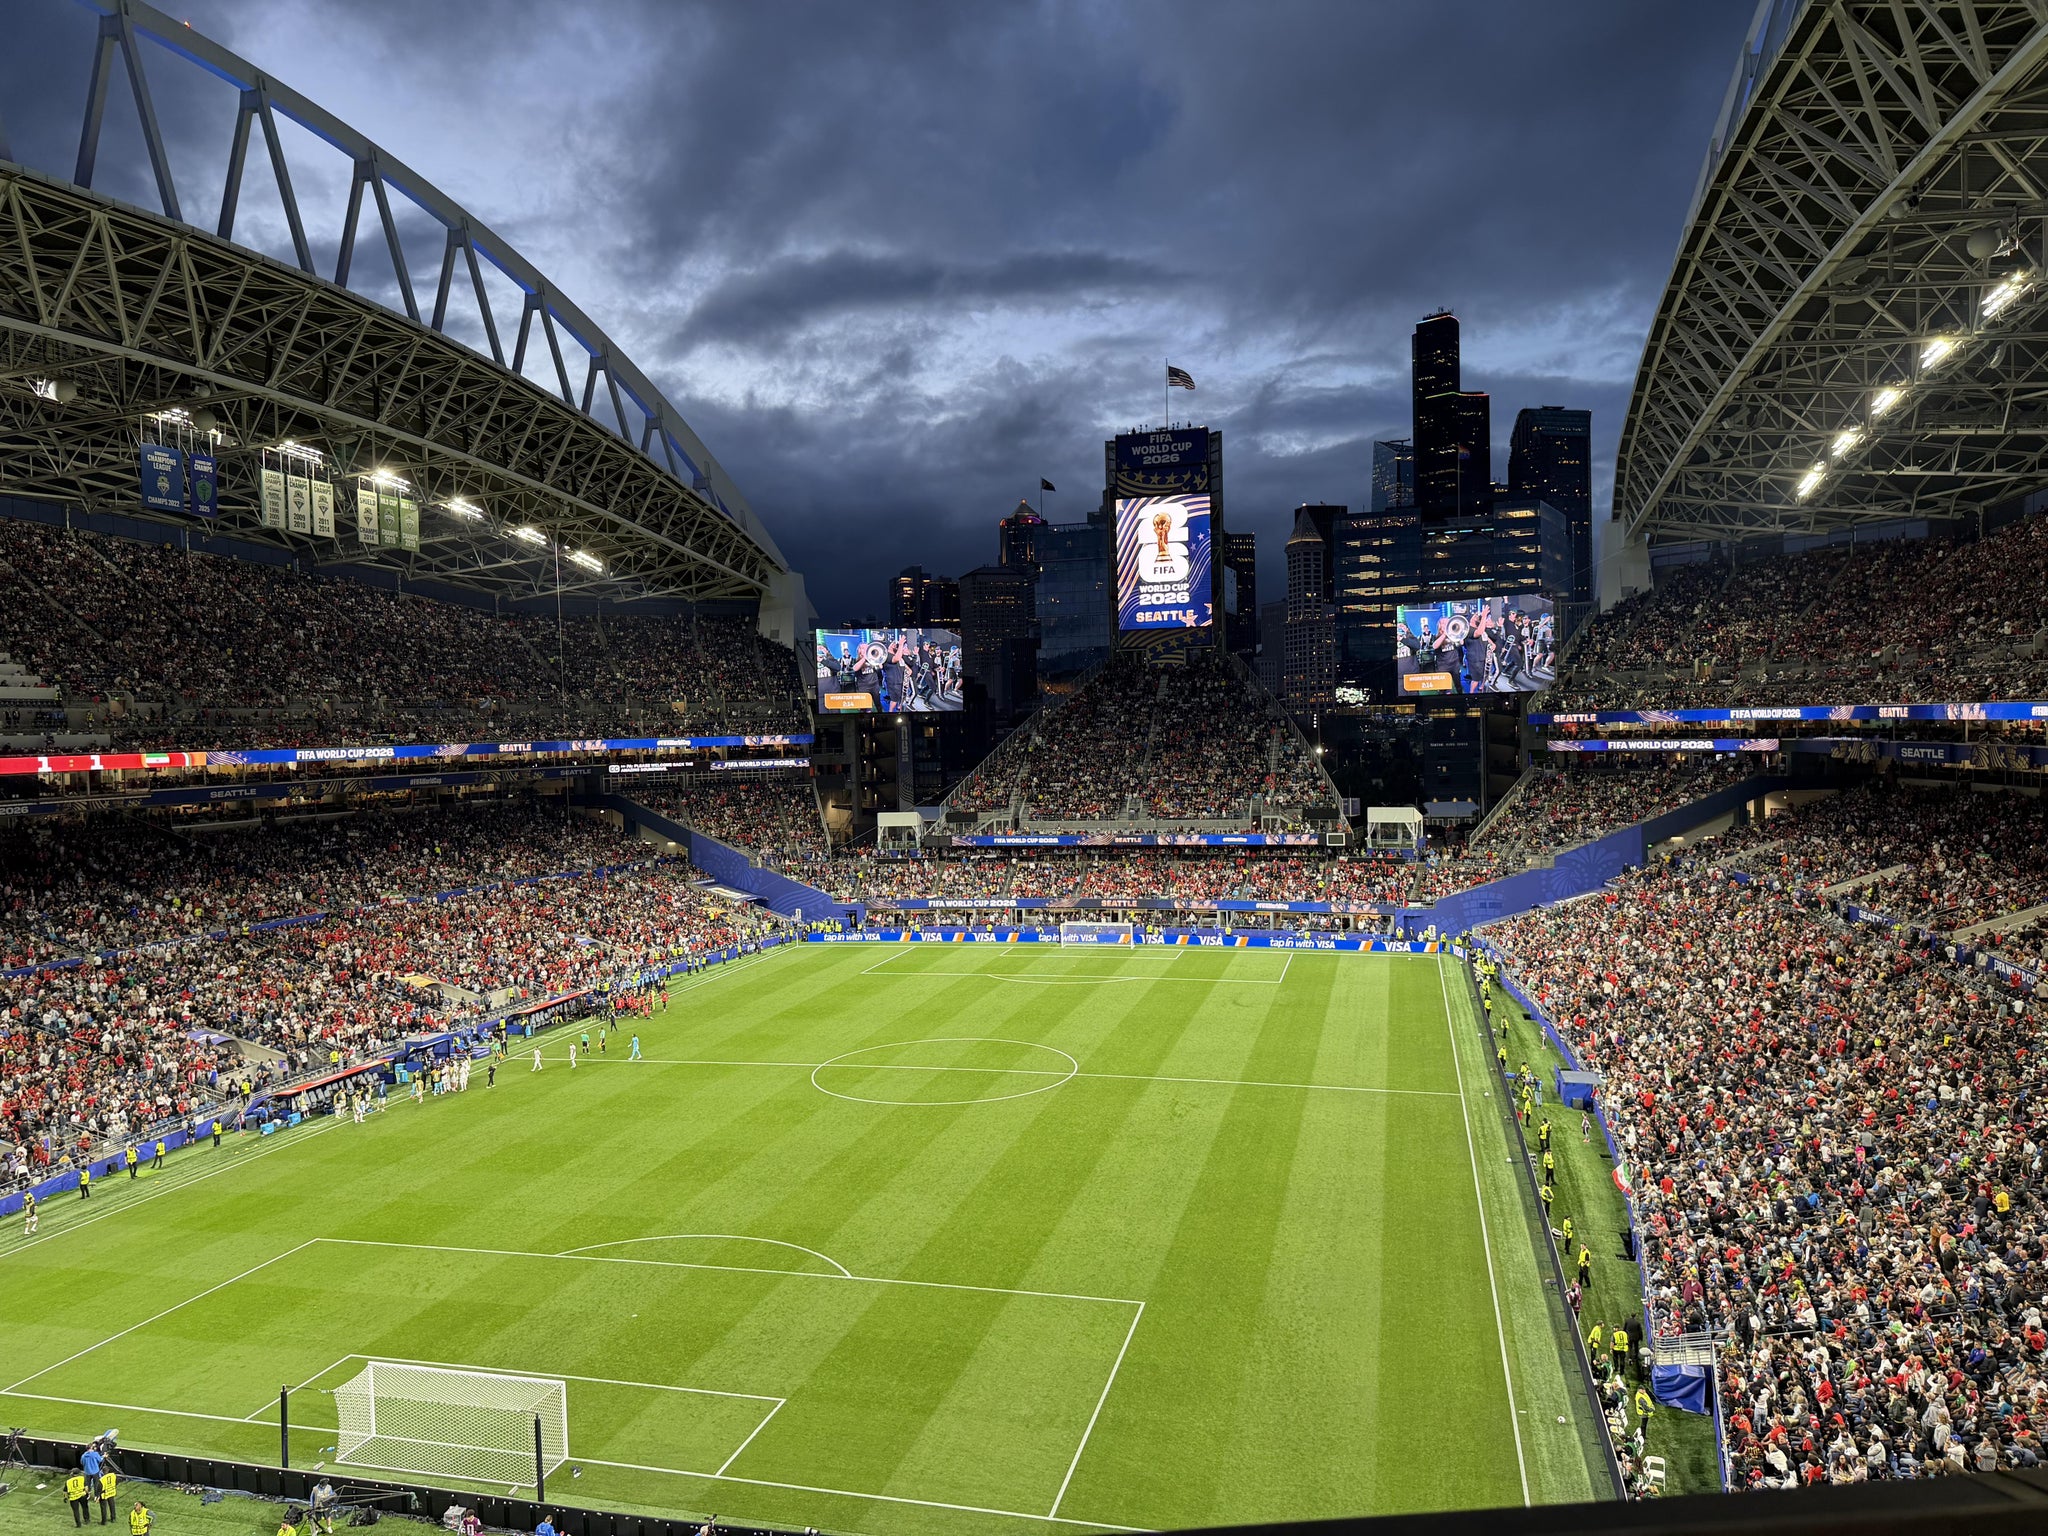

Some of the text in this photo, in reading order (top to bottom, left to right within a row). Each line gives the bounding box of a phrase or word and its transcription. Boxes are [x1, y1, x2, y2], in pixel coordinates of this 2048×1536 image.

[1150, 434, 1172, 443] FIFA
[1132, 442, 1192, 455] WORLD CUP
[147, 454, 176, 466] CHAMPIONS
[1142, 454, 1180, 464] 2026
[153, 462, 171, 472] LEAGUE
[148, 496, 167, 505] CHAMPS
[1153, 566, 1175, 574] FIFA
[1139, 583, 1189, 593] WORLD CUP
[1139, 592, 1190, 606] 2026
[1136, 610, 1194, 622] SEATTLE
[1730, 708, 1800, 719] FIFA WORLD CUP 2026
[1879, 707, 1908, 717] SEATTLE
[1553, 714, 1597, 723] SEATTLE
[499, 744, 531, 752] SEATTLE
[1608, 741, 1714, 750] FIFA WORLD CUP 2026
[296, 748, 394, 760] FIFA WORLD CUP 2026
[1901, 747, 1944, 759] SEATTLE
[38, 756, 52, 772] 1
[90, 755, 104, 770] 1
[560, 768, 591, 776] SEATTLE
[210, 788, 257, 798] SEATTLE
[0, 806, 28, 815] 2026
[919, 933, 943, 941] VISA
[972, 933, 996, 942] VISA
[1039, 934, 1052, 942] tap
[1139, 934, 1165, 944] VISA
[1198, 936, 1224, 946] VISA
[1270, 938, 1284, 948] tap
[1285, 937, 1294, 946] in
[1295, 940, 1314, 948] with
[1382, 941, 1411, 952] VISA
[2006, 964, 2026, 982] WOD
